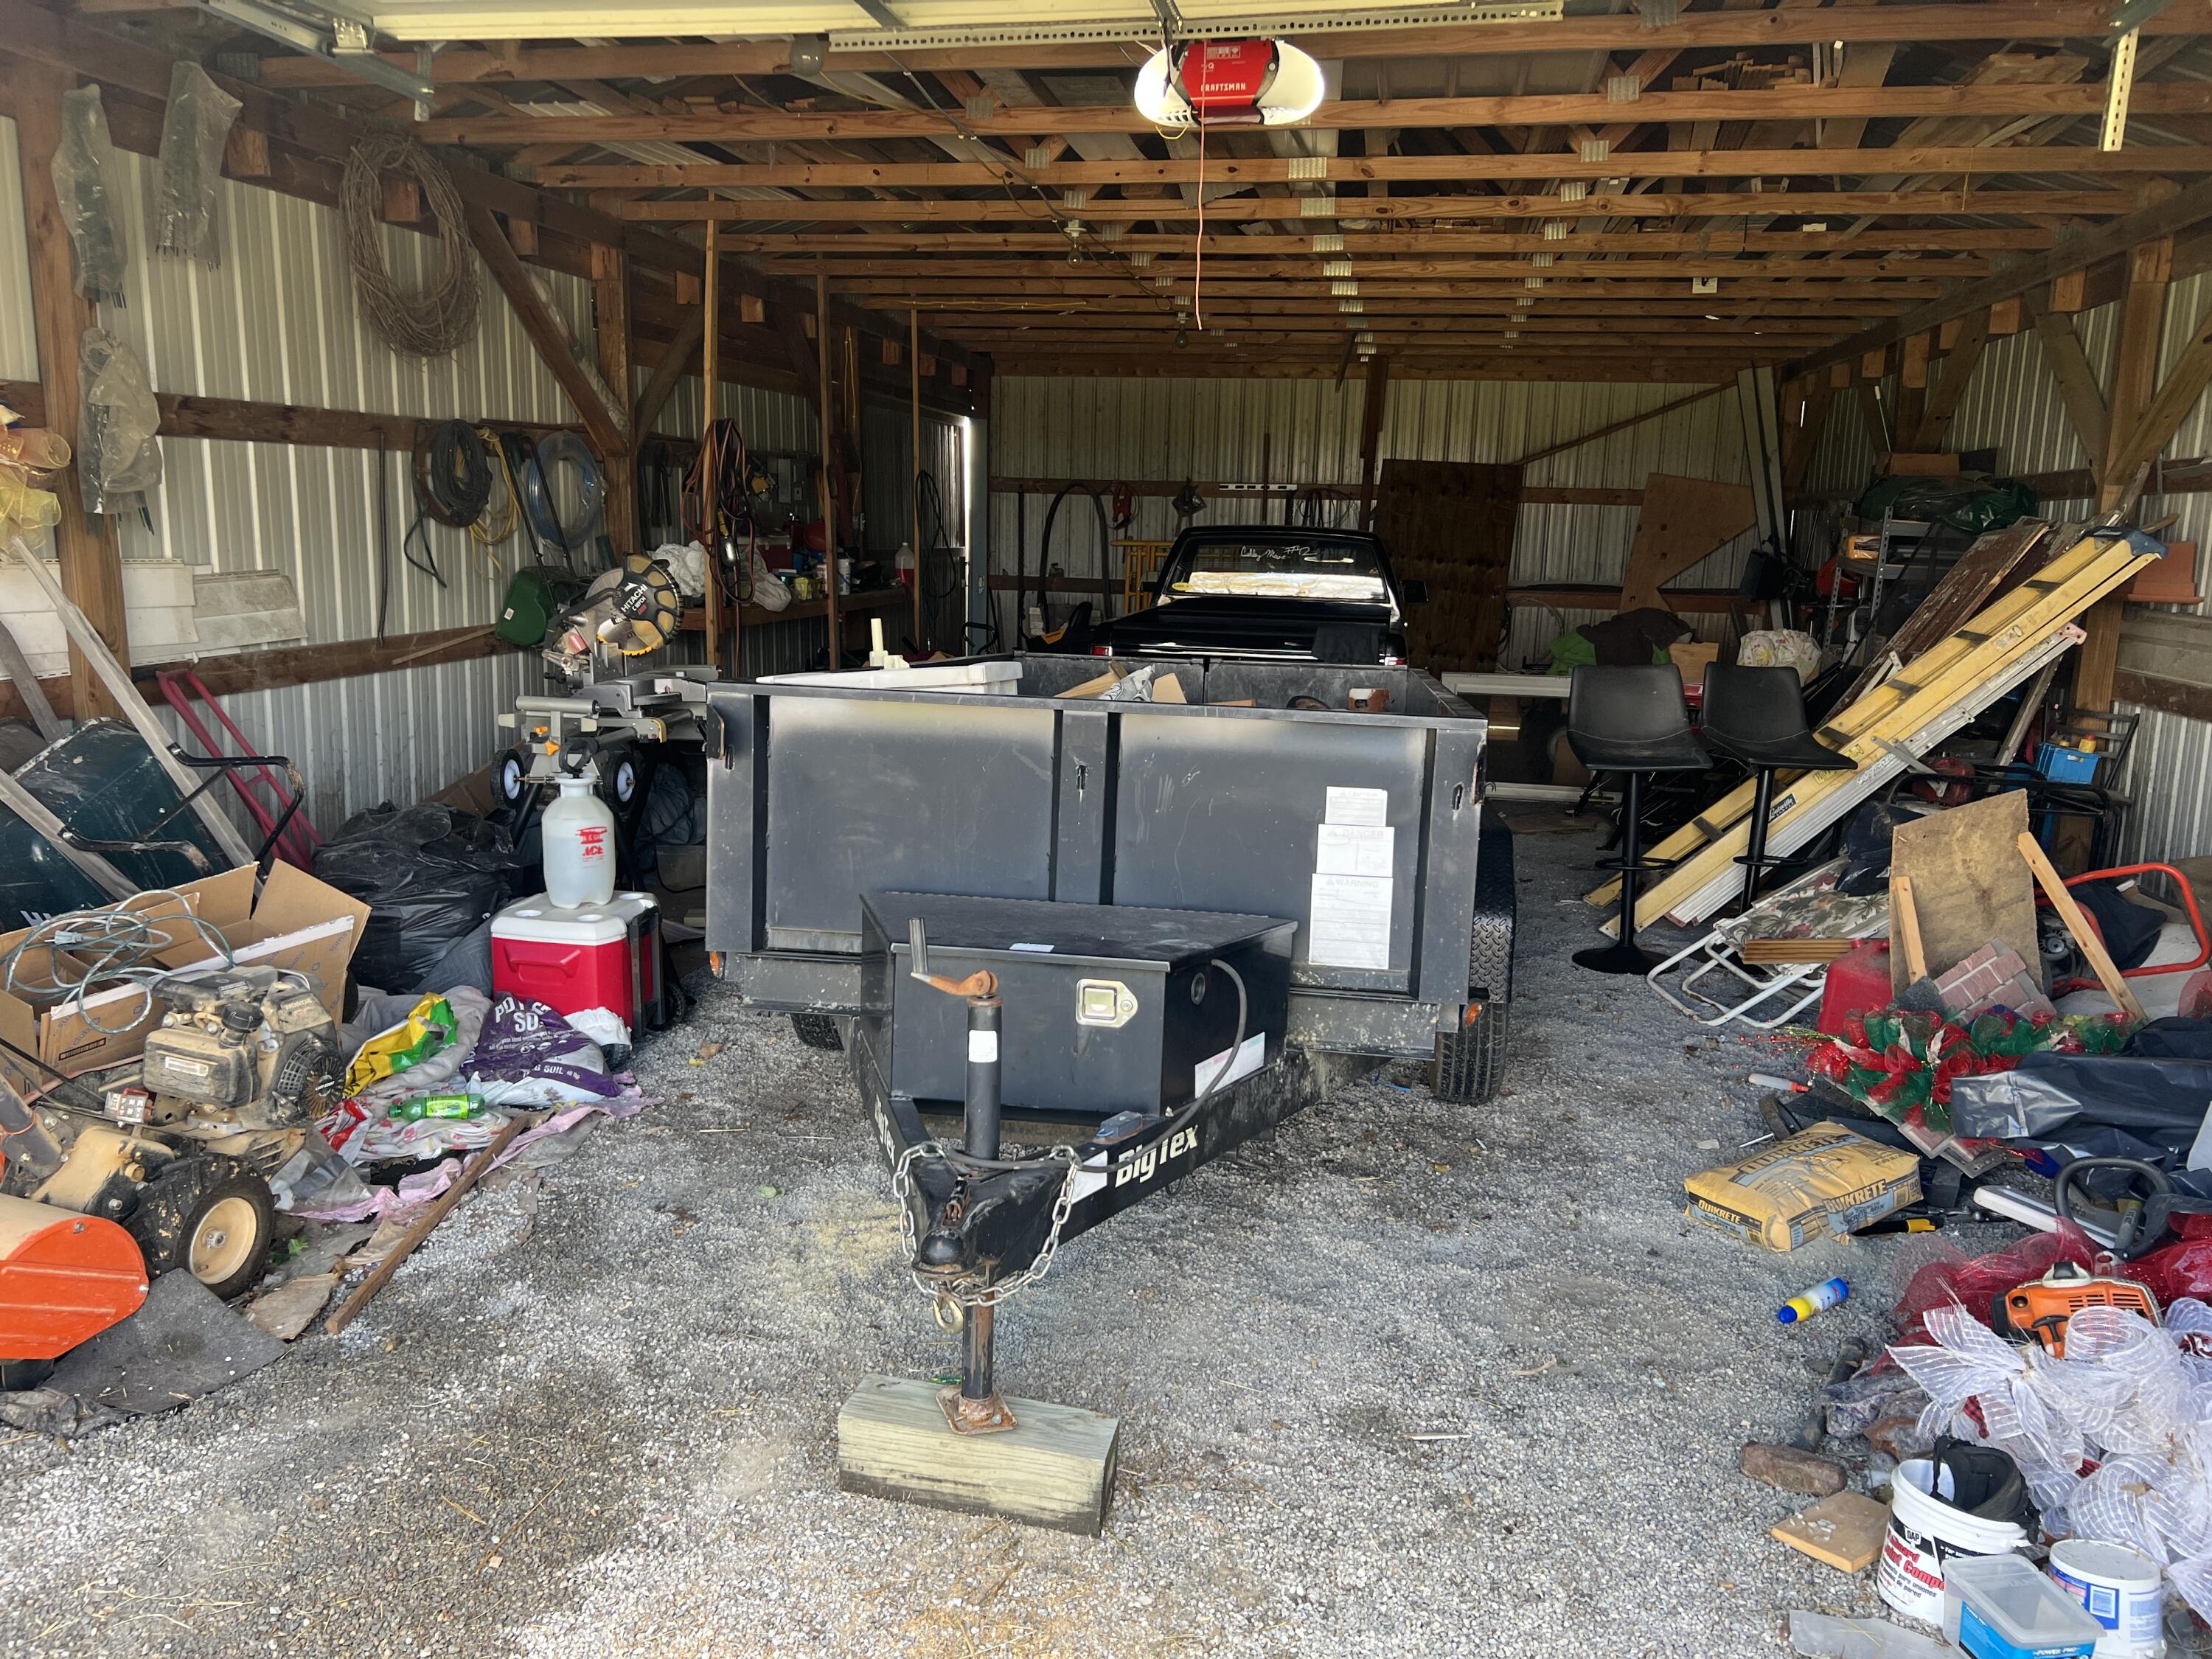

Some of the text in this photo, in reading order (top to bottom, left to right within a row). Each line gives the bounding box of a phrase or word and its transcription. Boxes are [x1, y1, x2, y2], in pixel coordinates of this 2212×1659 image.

[1201, 83, 1246, 92] CRAFTSMAN
[621, 584, 648, 613] HITACHI
[1343, 830, 1384, 838] DANGER
[1335, 879, 1380, 888] WARNING
[285, 998, 313, 1010] HONDA
[543, 1065, 563, 1075] SOIL
[1737, 1135, 1836, 1175] QUIKRETE
[1823, 1180, 1887, 1214] QUIKRETE
[1698, 1199, 1742, 1225] QUIKRETE
[1907, 1530, 1919, 1541] DAP
